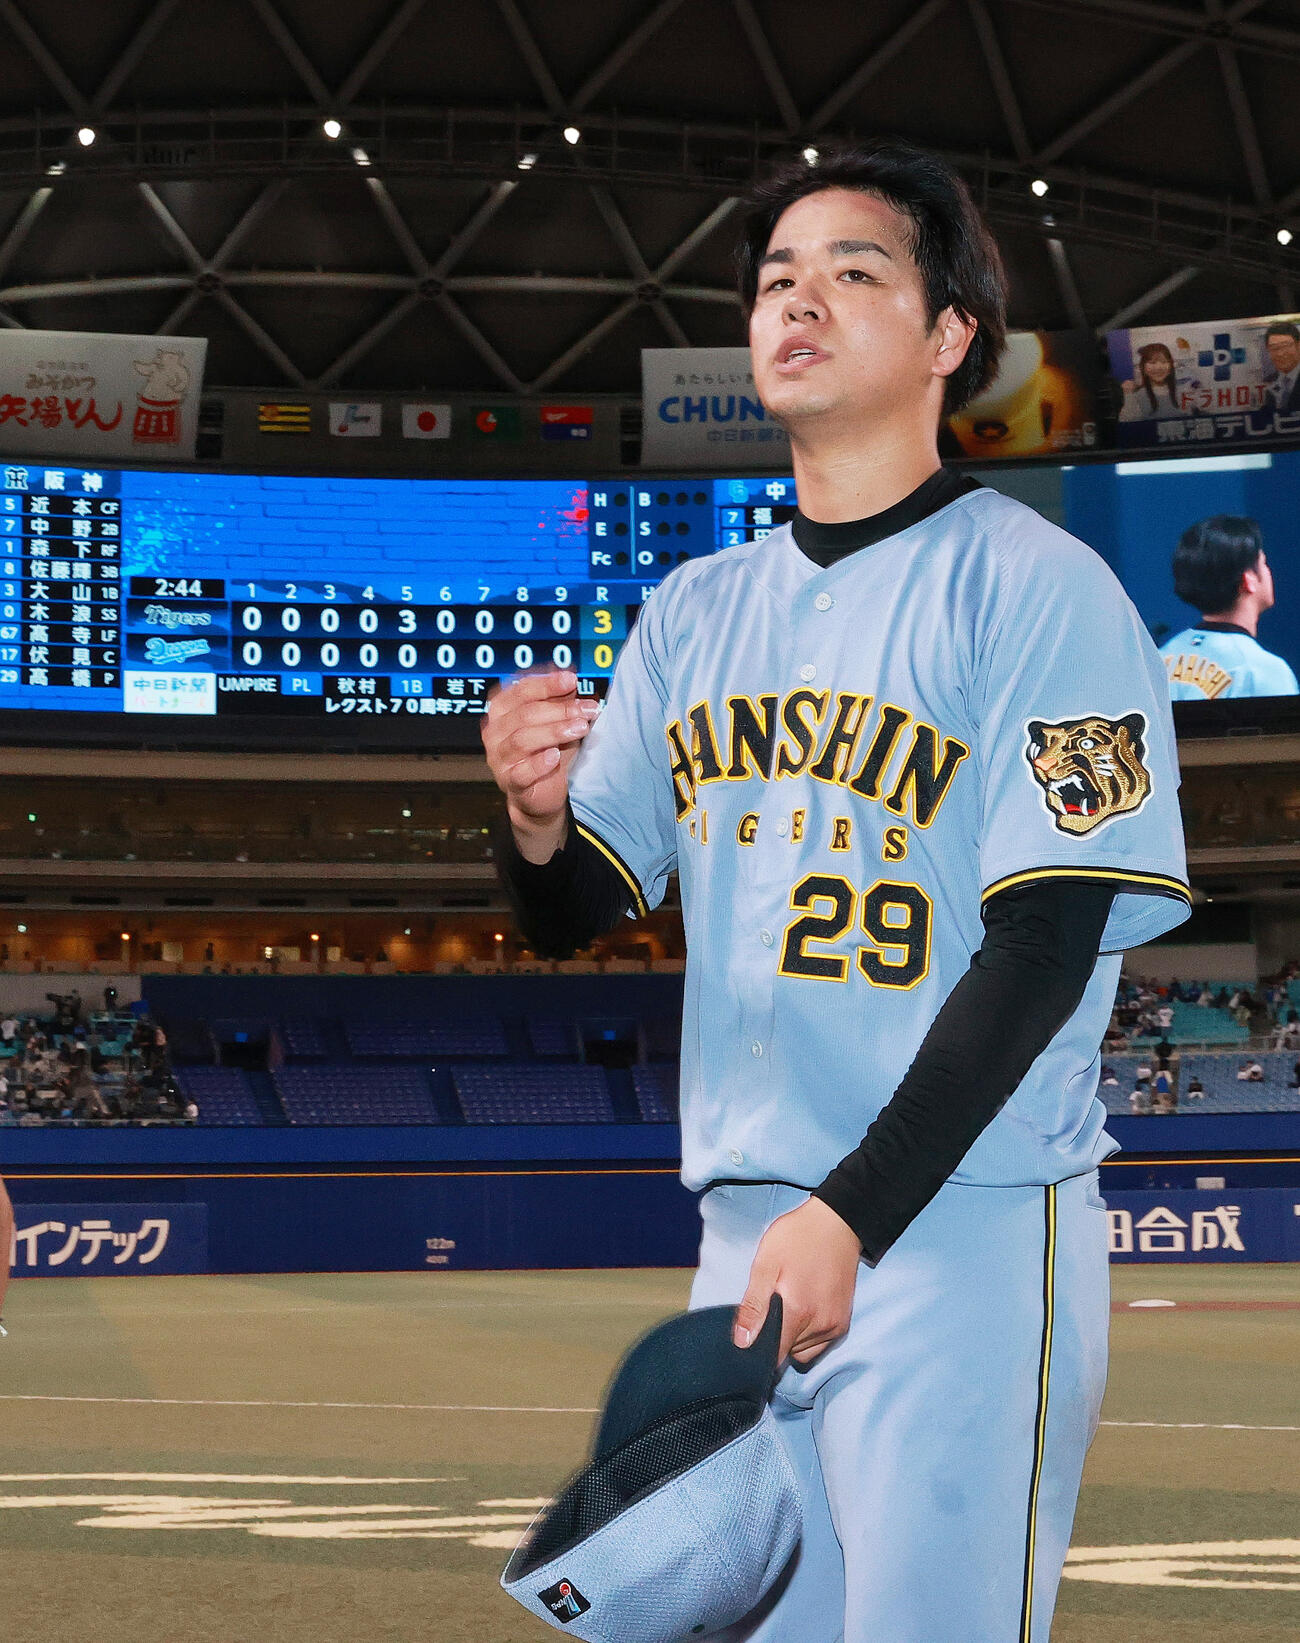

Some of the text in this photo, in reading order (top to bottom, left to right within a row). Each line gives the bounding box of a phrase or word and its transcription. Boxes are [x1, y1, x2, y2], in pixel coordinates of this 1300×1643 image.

[1181, 385, 1266, 411] ドラHOT
[0, 394, 123, 432] 矢場とん
[657, 396, 773, 424] CHUN
[44, 470, 102, 492] 阪神
[5, 496, 119, 517] 5 近本 CF
[594, 492, 651, 507] H B
[5, 519, 14, 531] 7
[30, 518, 92, 537] 中野
[728, 511, 738, 524] 7
[595, 521, 650, 536] E S
[729, 532, 739, 545] 2
[6, 541, 13, 553] 1
[30, 539, 92, 558] 森下
[592, 551, 653, 565] Fc O
[5, 562, 14, 575] 8
[30, 559, 92, 580] 佐藤輝
[5, 581, 118, 601] 3 大山 1B
[155, 578, 202, 597] 2:44
[248, 583, 256, 598] 1
[286, 583, 297, 599] 2
[324, 584, 336, 599] 3
[362, 586, 374, 600] 4
[401, 586, 413, 601] 5
[440, 586, 452, 601] 6
[479, 586, 490, 601] 7
[516, 586, 529, 601] 8
[555, 586, 567, 602] 9
[597, 586, 609, 601] R
[4, 603, 118, 623] 0 木浪 SS
[243, 607, 262, 632] 0
[282, 607, 300, 632] 0
[321, 608, 339, 633] 0
[359, 609, 378, 634] 0
[398, 609, 417, 634] 3
[437, 610, 455, 635] 0
[475, 610, 494, 635] 0
[514, 610, 532, 635] 0
[552, 610, 571, 635] 0
[593, 610, 613, 634] 3
[0, 627, 17, 639] 67
[101, 629, 117, 642] LF
[1, 646, 115, 666] 17 伏見 C
[243, 641, 263, 666] 0
[282, 642, 301, 667] 0
[321, 643, 340, 668] 0
[359, 643, 379, 668] 0
[398, 644, 418, 669] 0
[437, 644, 456, 669] 0
[475, 644, 495, 669] 0
[514, 644, 533, 669] 0
[552, 644, 572, 669] 0
[593, 644, 614, 668] 0
[0, 669, 18, 682] 29
[104, 672, 114, 685] P
[133, 677, 207, 693] 中日新聞
[218, 677, 277, 692] UMPIRE
[292, 679, 311, 692] PL
[337, 678, 377, 695] 秋村
[401, 679, 423, 694] 1B
[447, 678, 486, 695] 岩下
[666, 686, 971, 830] HANSHIN
[777, 871, 933, 991] 29
[8, 1219, 170, 1267] インテック
